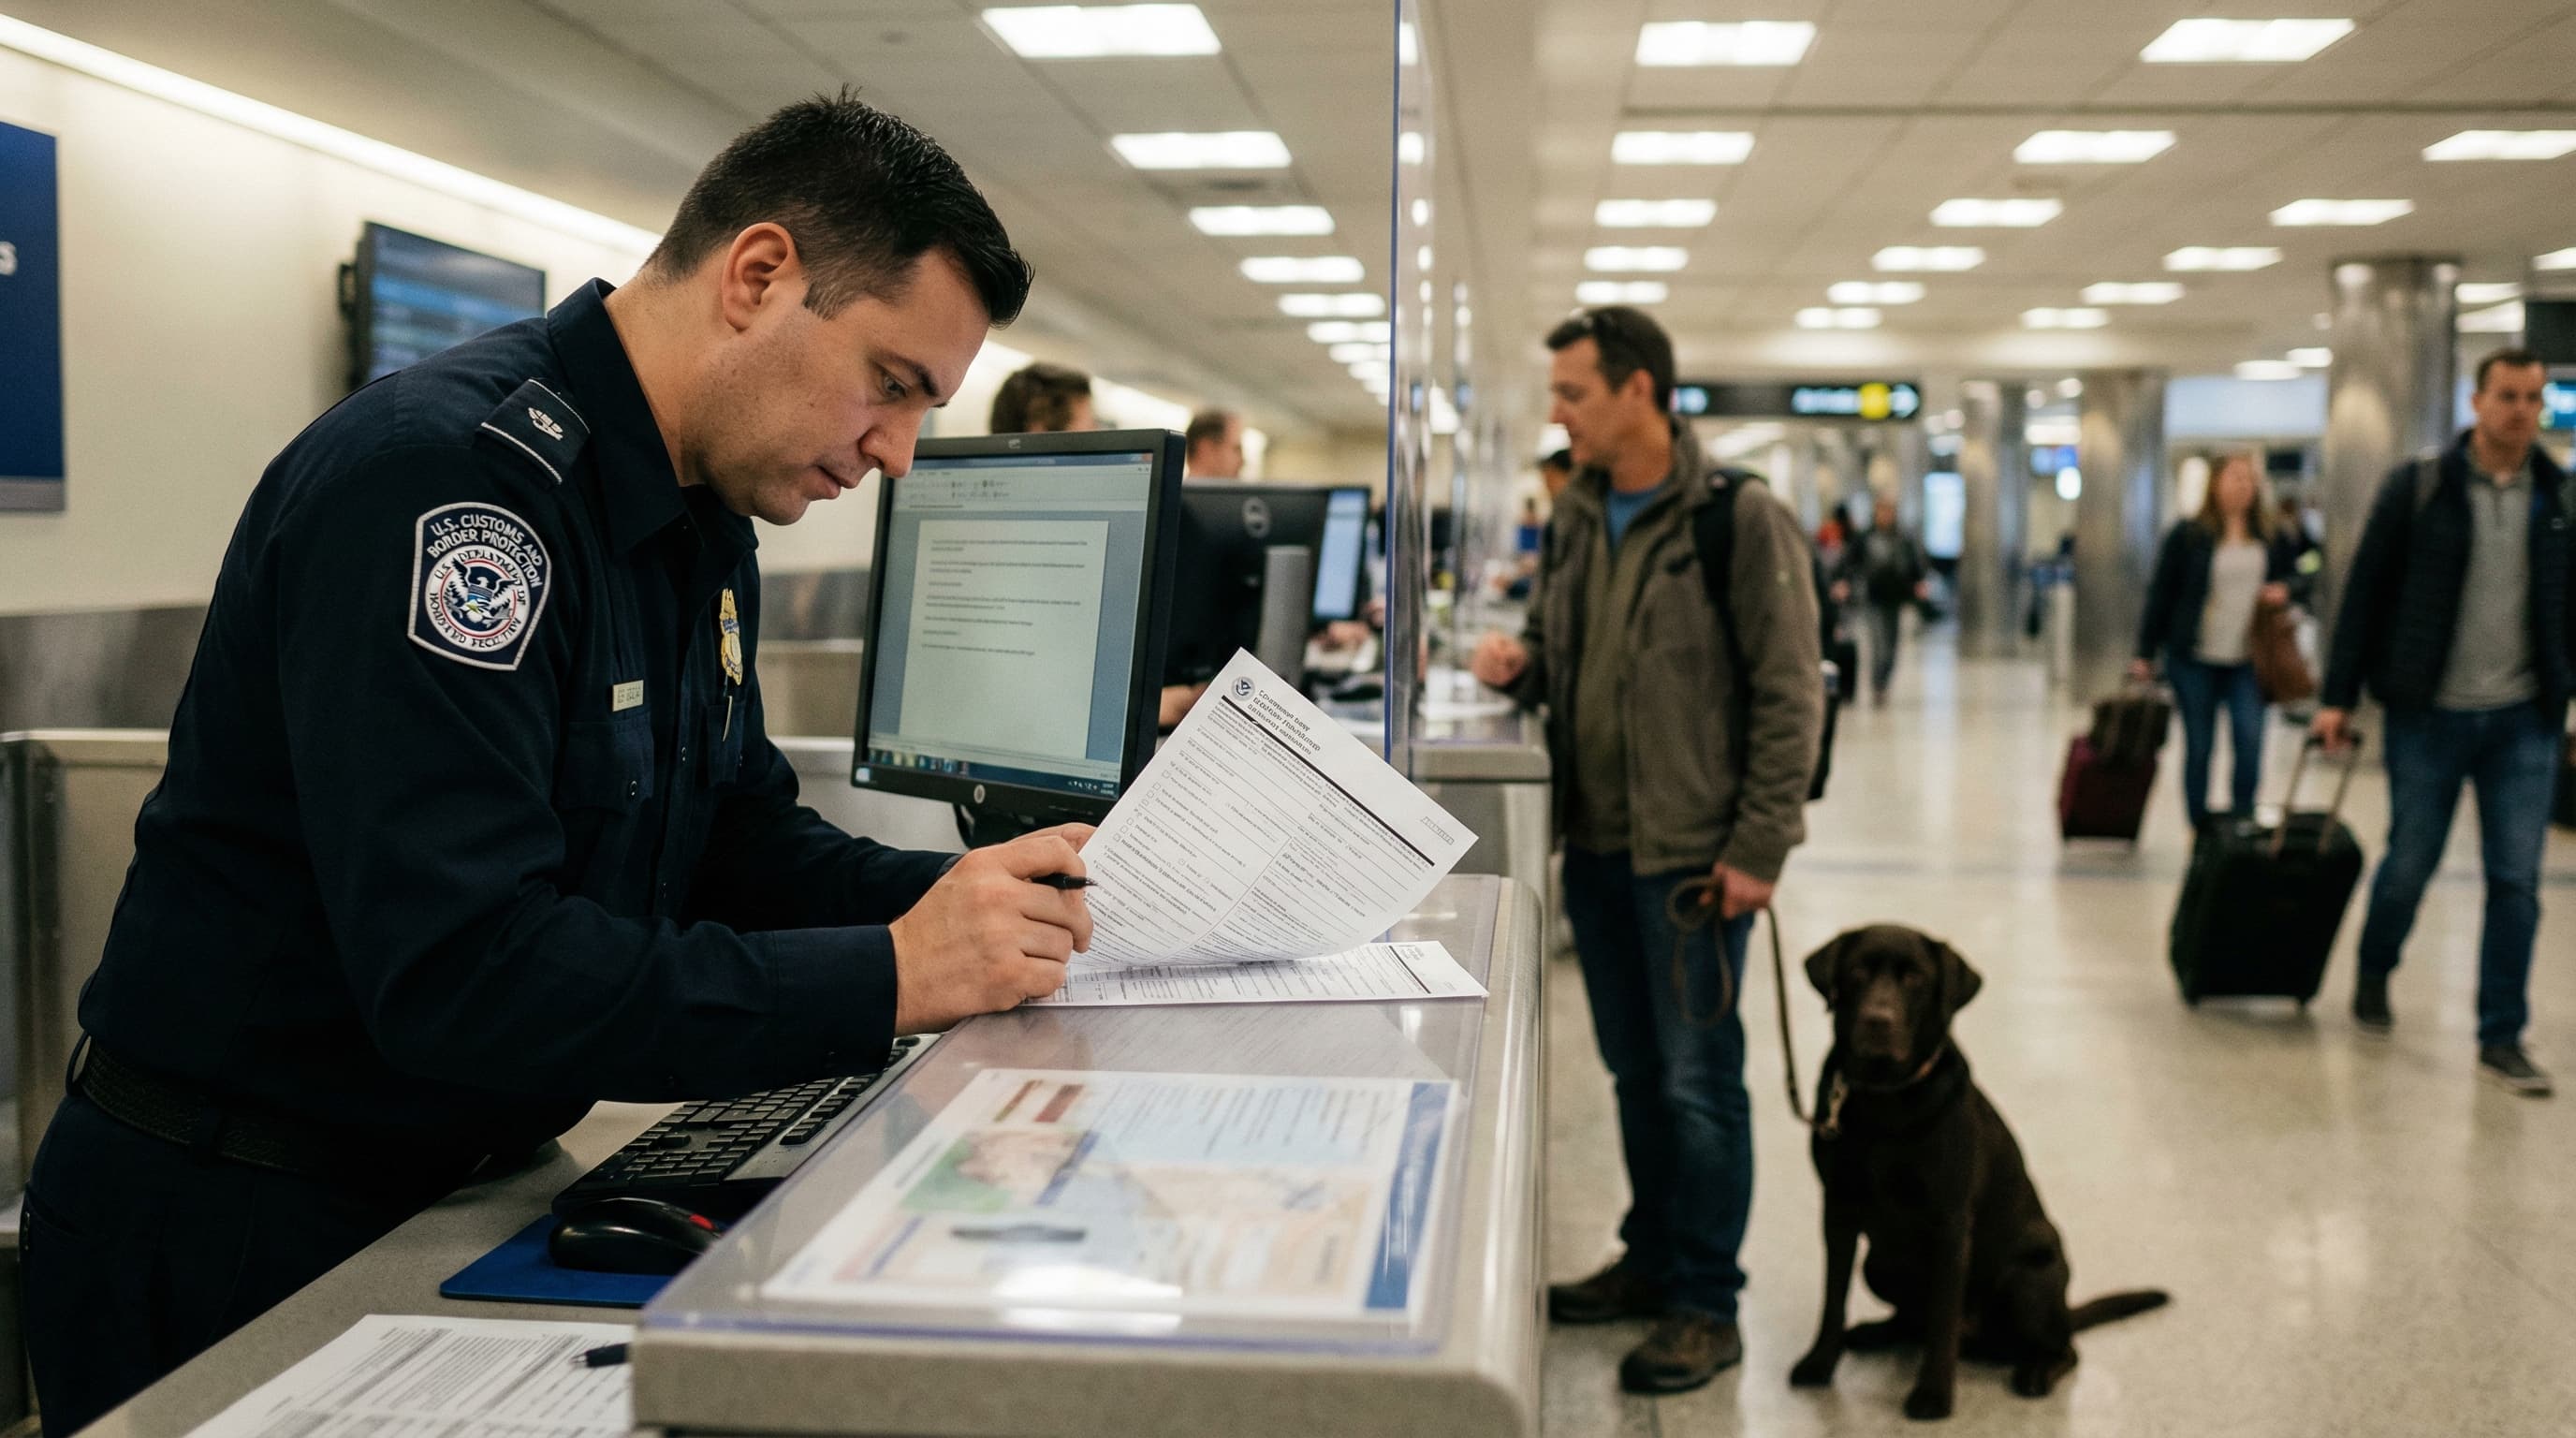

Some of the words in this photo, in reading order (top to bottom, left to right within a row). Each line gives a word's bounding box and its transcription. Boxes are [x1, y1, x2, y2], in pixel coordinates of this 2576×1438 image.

[427, 531, 478, 558] BORDER
[481, 530, 543, 588] PROTECTION
[431, 518, 459, 536] U.S.
[461, 515, 525, 543] CUSTOMS
[523, 544, 543, 566] AND
